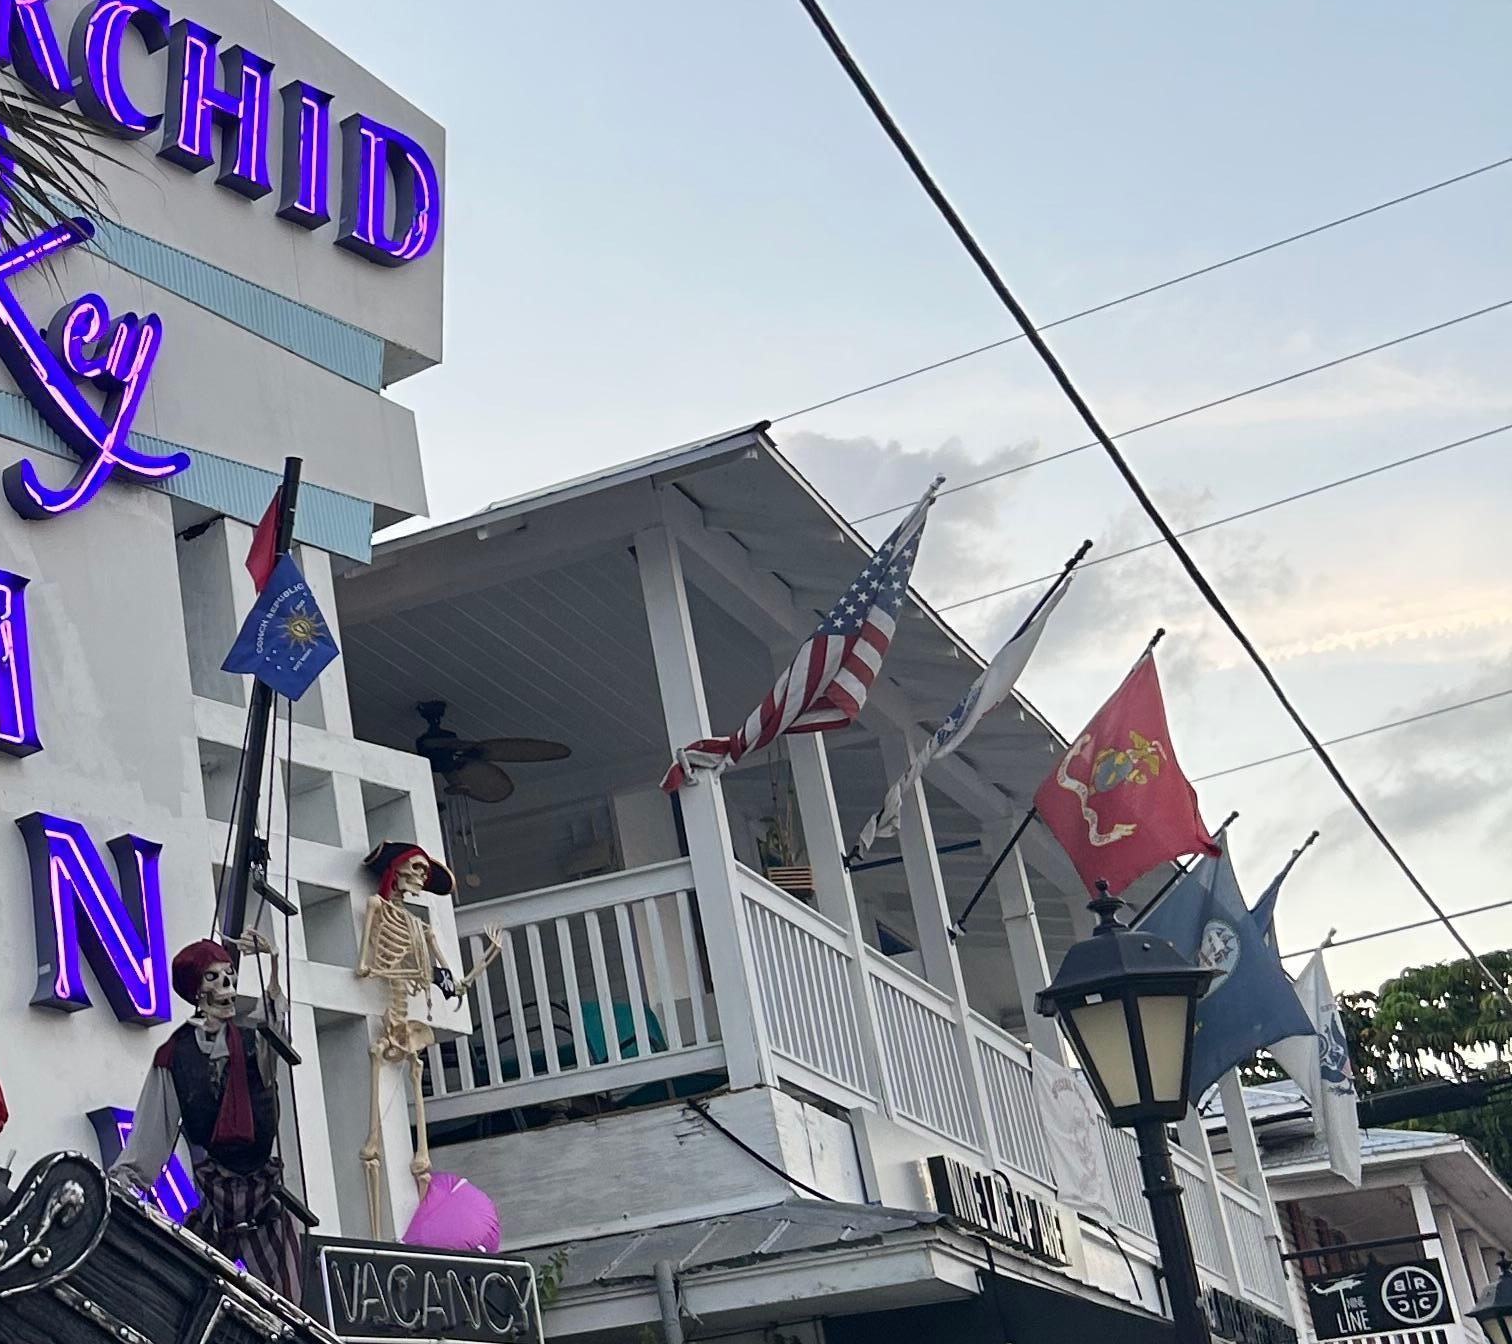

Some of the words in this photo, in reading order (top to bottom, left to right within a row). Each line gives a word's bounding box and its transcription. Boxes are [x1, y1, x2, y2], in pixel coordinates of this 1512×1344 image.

[255, 618, 269, 654] CONCH
[330, 1260, 533, 1335] VACANCY
[1336, 1297, 1372, 1334] LINE
